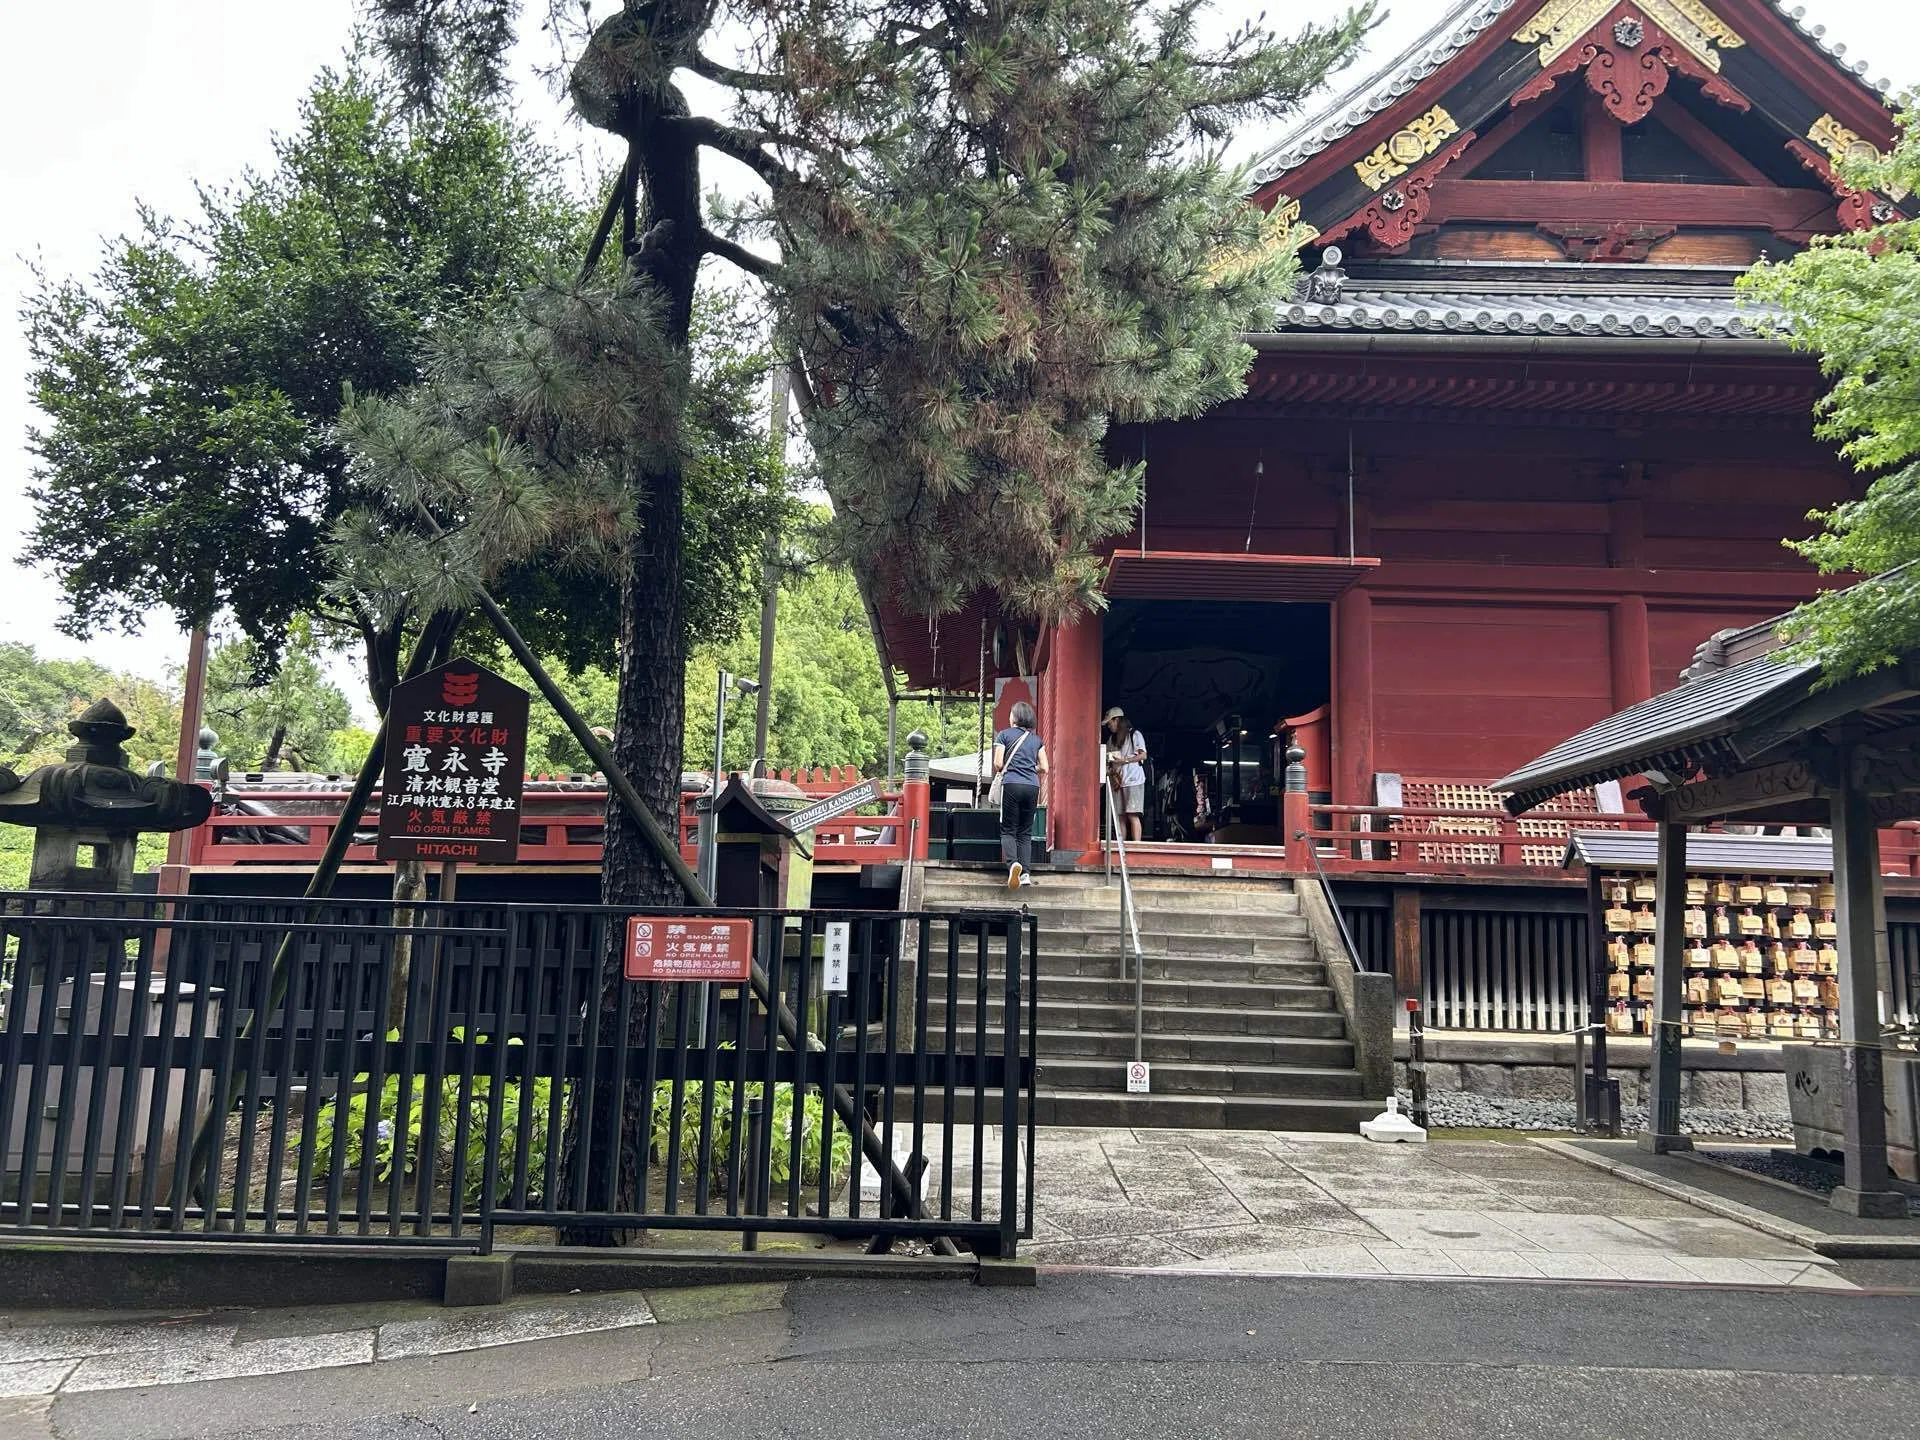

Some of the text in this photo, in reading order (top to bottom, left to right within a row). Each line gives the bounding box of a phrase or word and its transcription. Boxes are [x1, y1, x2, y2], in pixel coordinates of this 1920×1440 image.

[423, 710, 494, 724] 文化財愛護
[404, 726, 510, 745] 重要文化財
[401, 744, 509, 776] 寛永寺
[405, 775, 500, 794] 清水観音堂
[387, 794, 516, 810] 江戸時代寛永8年建立
[790, 804, 828, 826] KIYOMIZU
[828, 784, 872, 810] KANNON-DO
[408, 810, 493, 826] 火気厳禁
[407, 825, 491, 836] NO OPEN FLAMES
[416, 843, 478, 856] HITACHI
[667, 924, 731, 935] 禁煙
[665, 943, 729, 953] 火気厳禁
[831, 927, 843, 985] 宴席禁止
